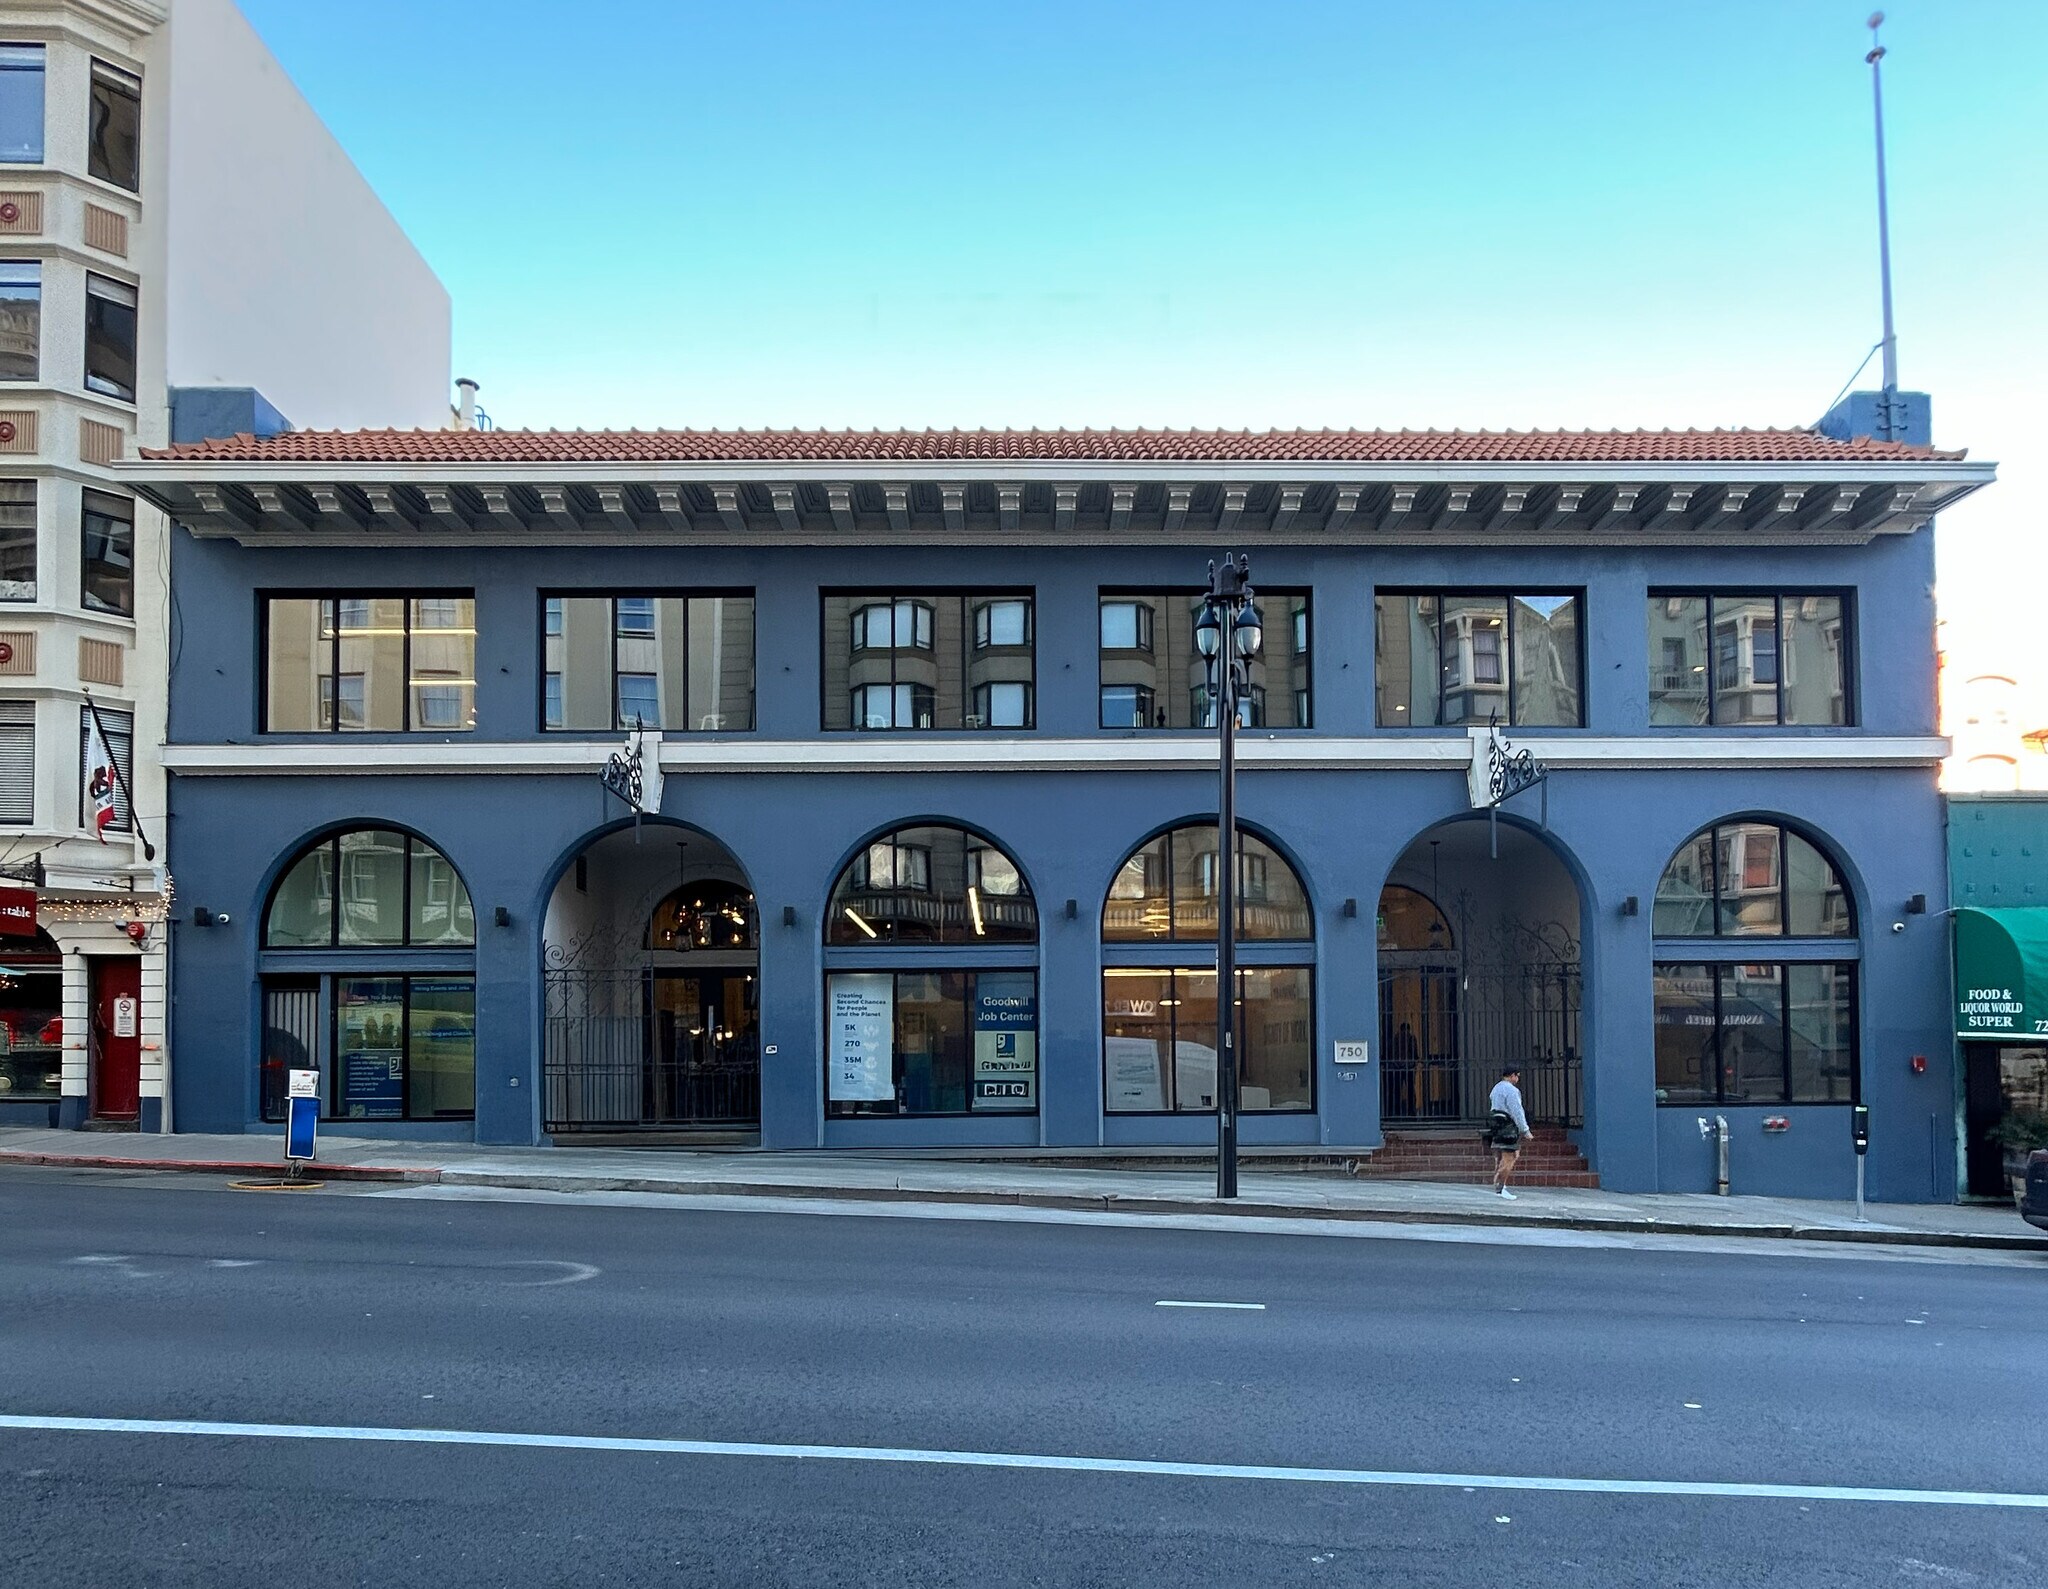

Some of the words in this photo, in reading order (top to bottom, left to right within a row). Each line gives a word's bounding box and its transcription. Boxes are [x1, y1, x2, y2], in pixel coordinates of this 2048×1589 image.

[1968, 989, 2000, 1000] FOOD
[2002, 988, 2012, 1000] &
[983, 996, 1029, 1006] Goodwill
[1960, 1002, 1990, 1015] LIQUOR
[1991, 1002, 2023, 1014] WORLD
[978, 1011, 998, 1022] Job
[999, 1011, 1034, 1022] Center
[1968, 1015, 2013, 1027] SUPER
[844, 1023, 857, 1031] 5K
[1340, 1047, 1362, 1057] 750
[844, 1056, 862, 1064] 35M
[844, 1072, 855, 1080] 34
